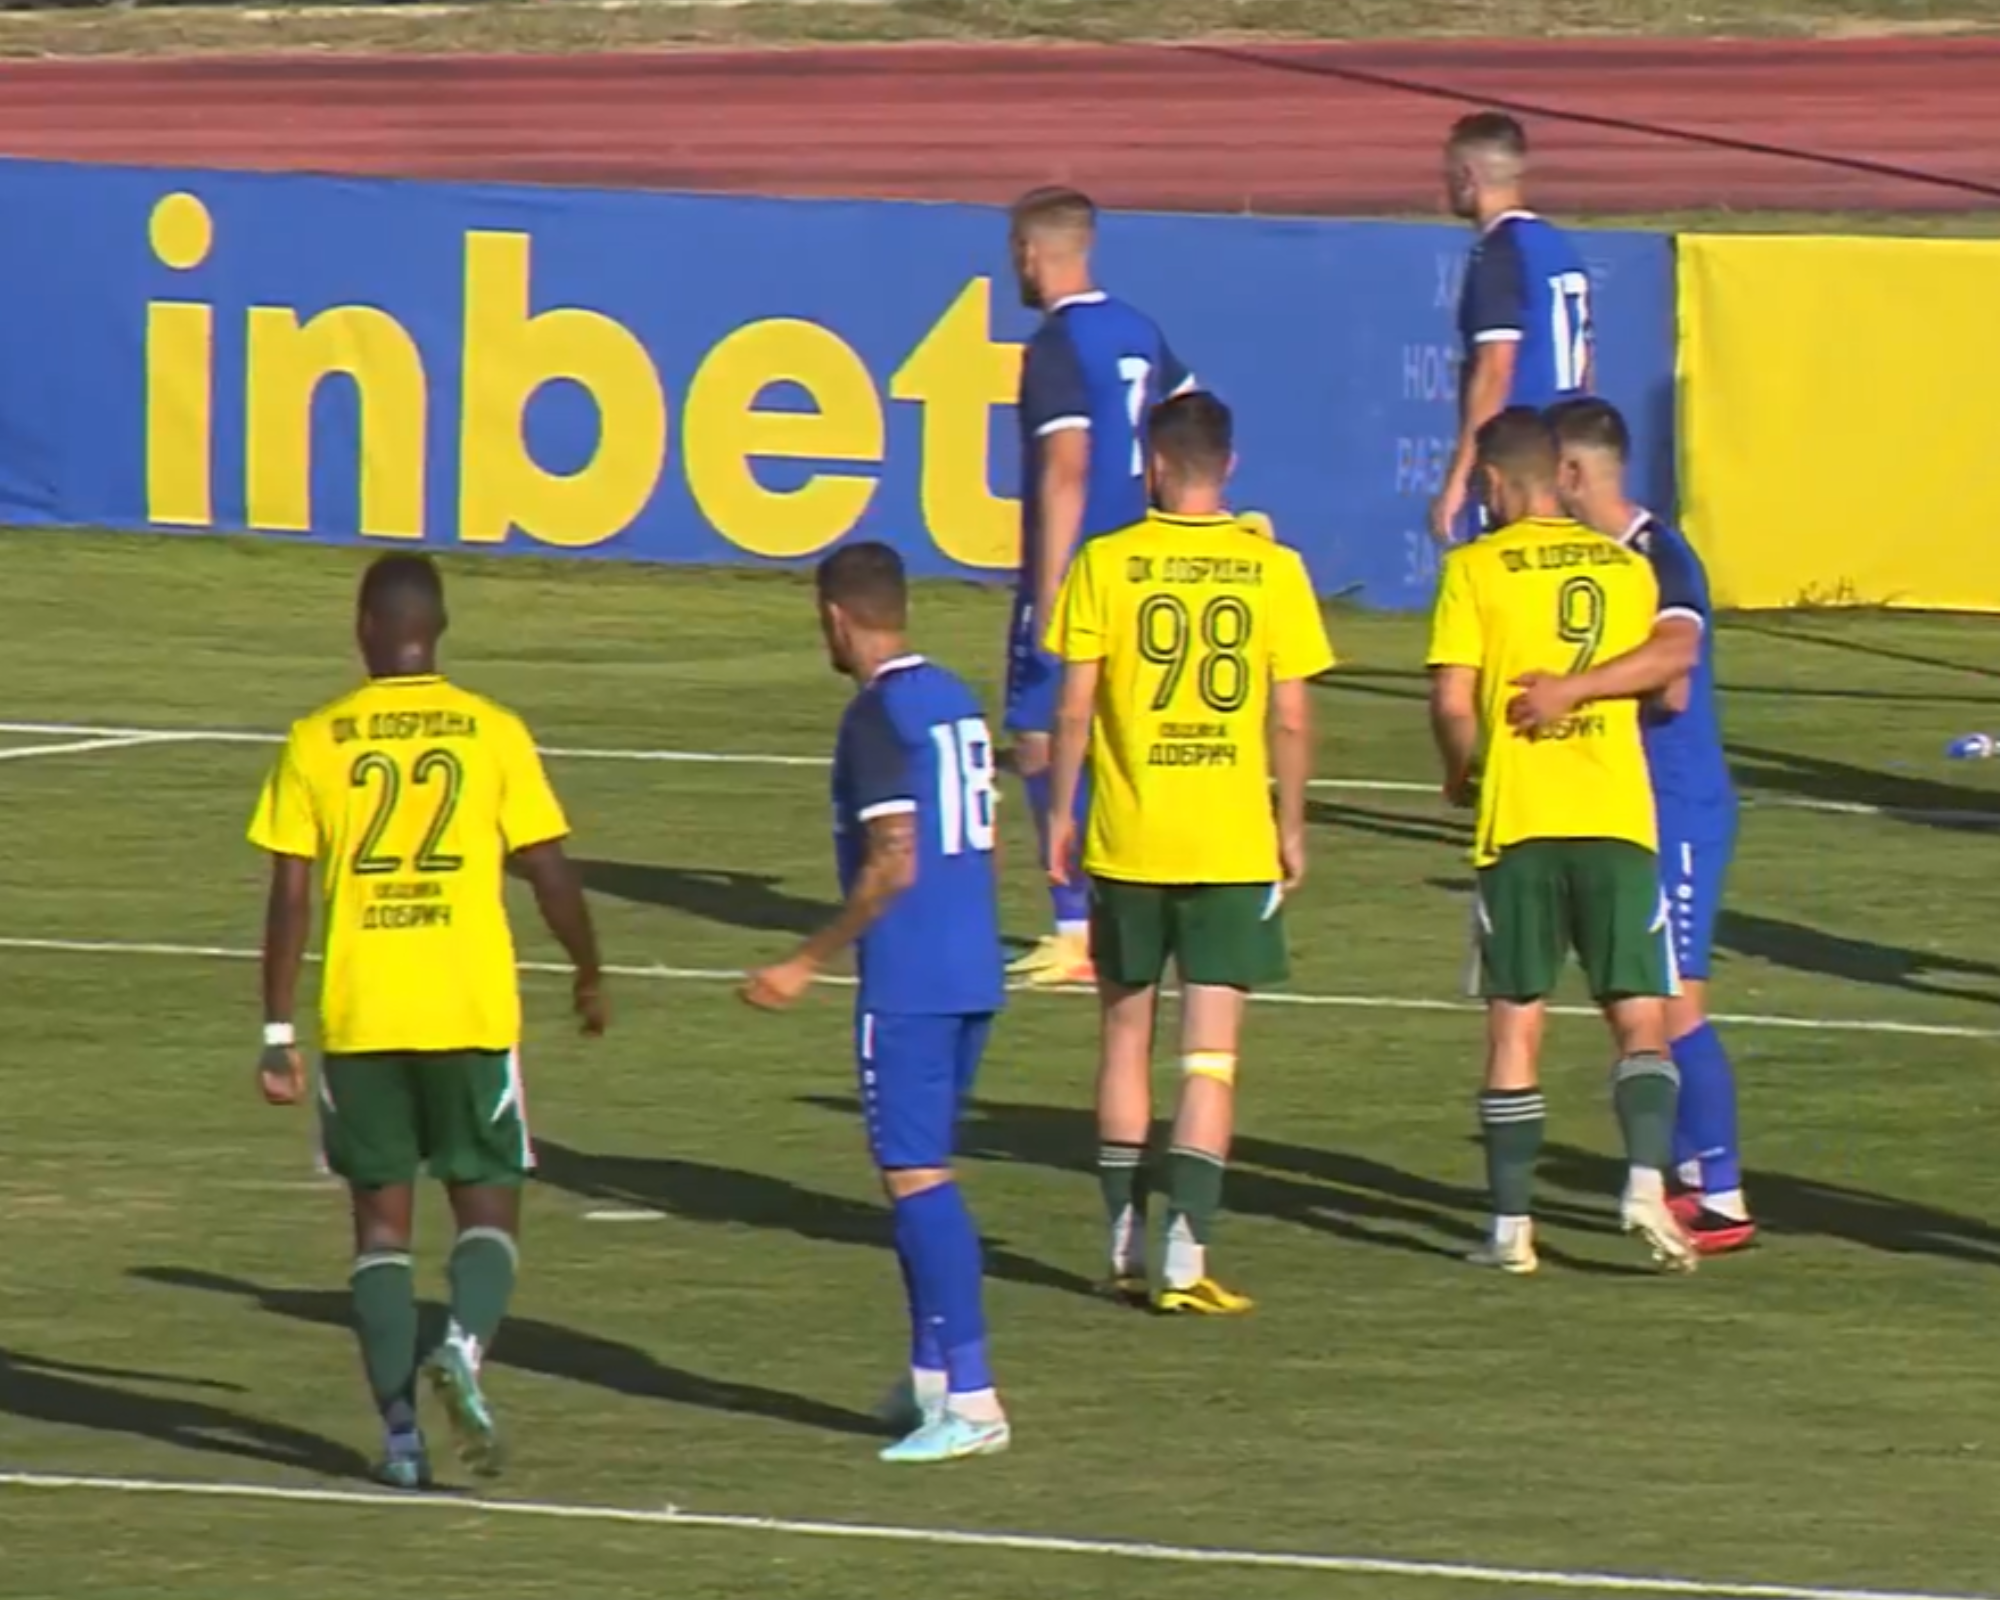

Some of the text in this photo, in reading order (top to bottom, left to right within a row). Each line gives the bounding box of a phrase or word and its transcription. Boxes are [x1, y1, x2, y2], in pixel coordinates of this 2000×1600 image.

[147, 192, 1023, 569] inbet
[1548, 271, 1589, 391] 17
[1117, 356, 1151, 477] 7
[1138, 592, 1252, 712] 98
[1559, 576, 1605, 676] 9
[351, 748, 463, 875] 22
[929, 717, 996, 855] 18
[1147, 743, 1237, 766] ДОБРИЧ
[361, 906, 453, 929] ДОБРИЧ
